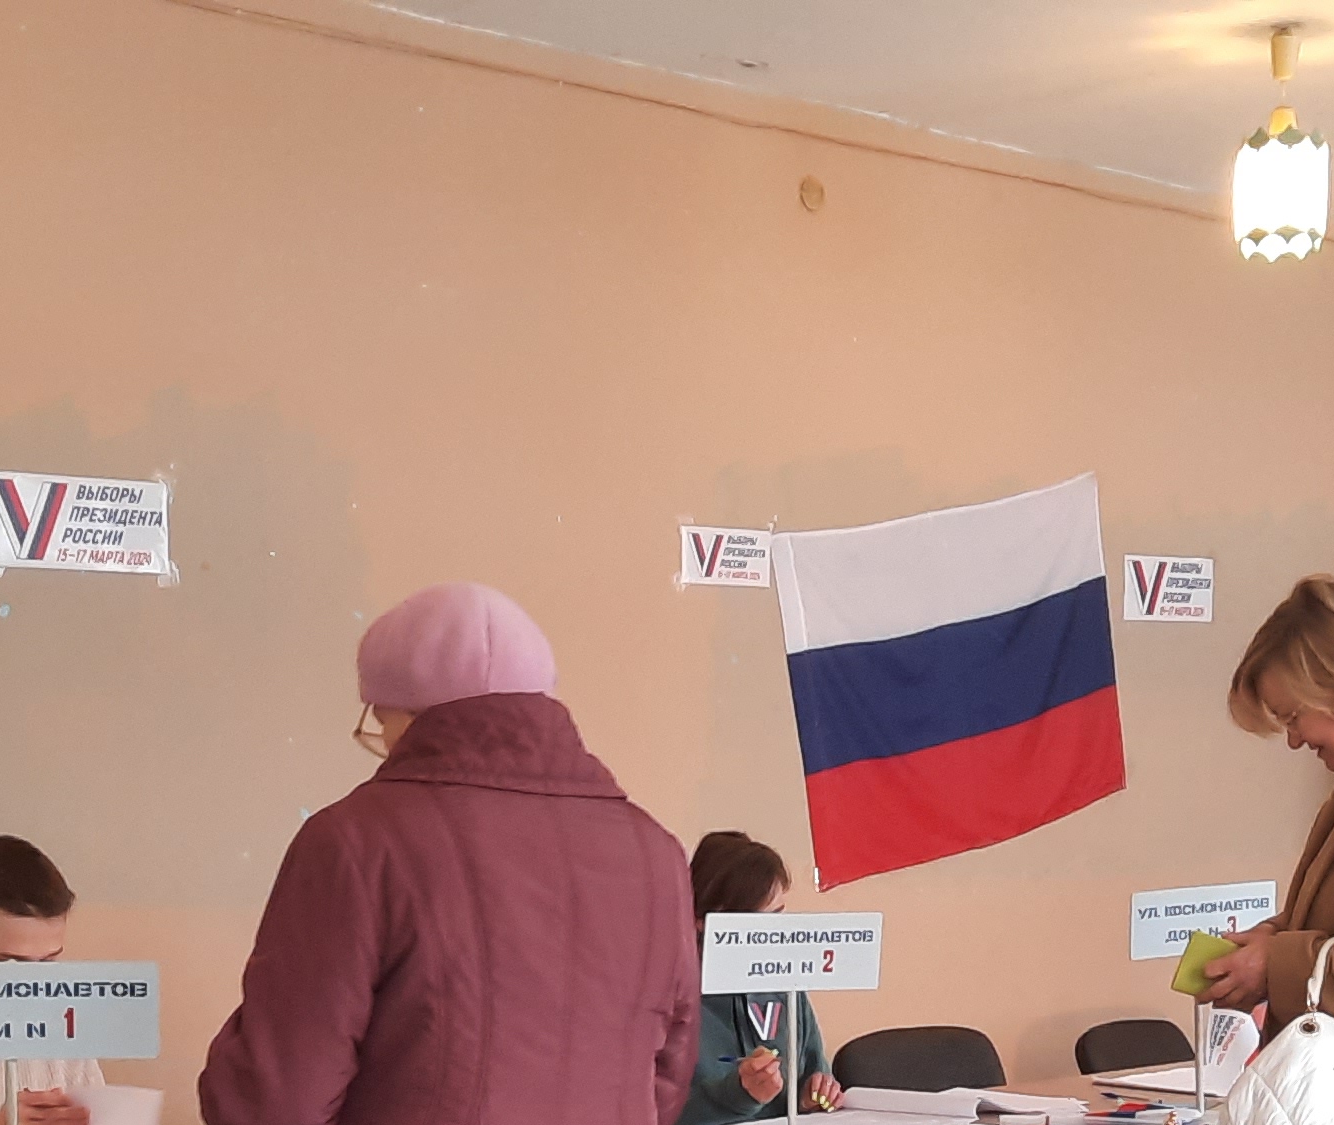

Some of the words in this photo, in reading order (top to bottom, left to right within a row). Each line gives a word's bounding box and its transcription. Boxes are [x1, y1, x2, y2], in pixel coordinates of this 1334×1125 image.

[75, 484, 144, 504] ВЫБОРЫ
[68, 505, 163, 528] ПРЕЗИДЕНТА
[61, 527, 125, 546] РОССИИ
[88, 549, 125, 565] МАРТА
[1164, 897, 1270, 918] КОСМОНАВТОВ
[1226, 915, 1237, 933] 3
[714, 931, 744, 945] УЛ.
[746, 929, 874, 945] КОСМОНАВТОВ
[747, 961, 792, 977] ДОМ
[801, 961, 814, 974] N
[822, 949, 835, 973] 2
[26, 1022, 46, 1038] N
[63, 1007, 75, 1039] 1
